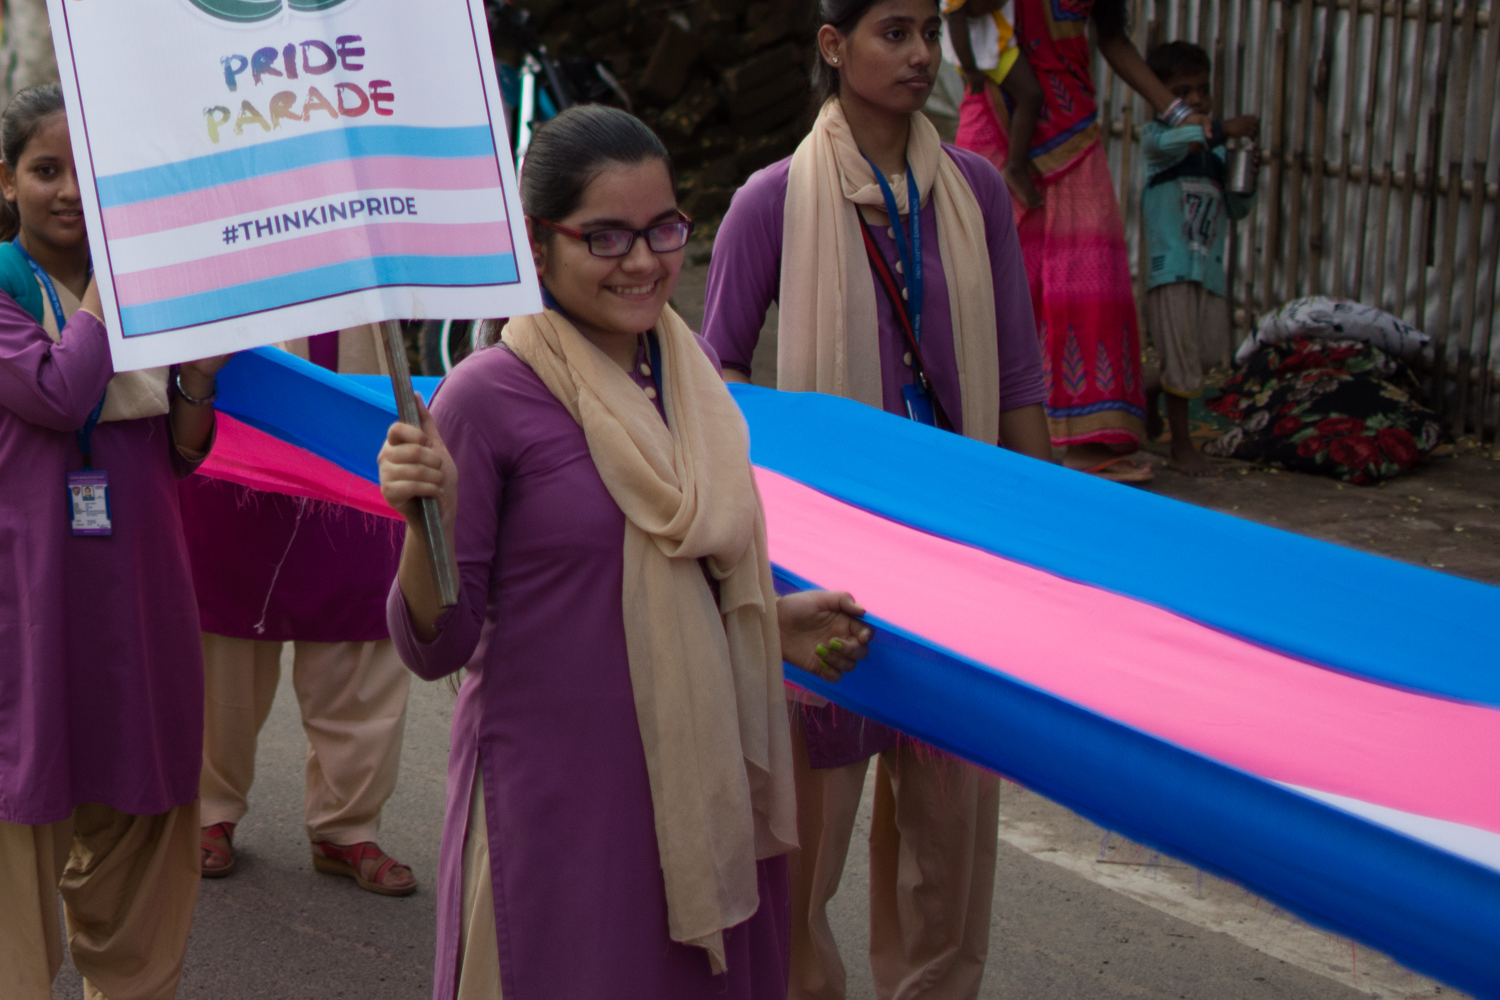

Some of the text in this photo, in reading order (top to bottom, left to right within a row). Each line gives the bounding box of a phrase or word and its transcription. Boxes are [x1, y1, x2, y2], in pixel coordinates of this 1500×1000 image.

[220, 34, 366, 92] PRIDE
[202, 79, 395, 144] PARADE
[221, 196, 418, 245] #THINKINPRIDE
